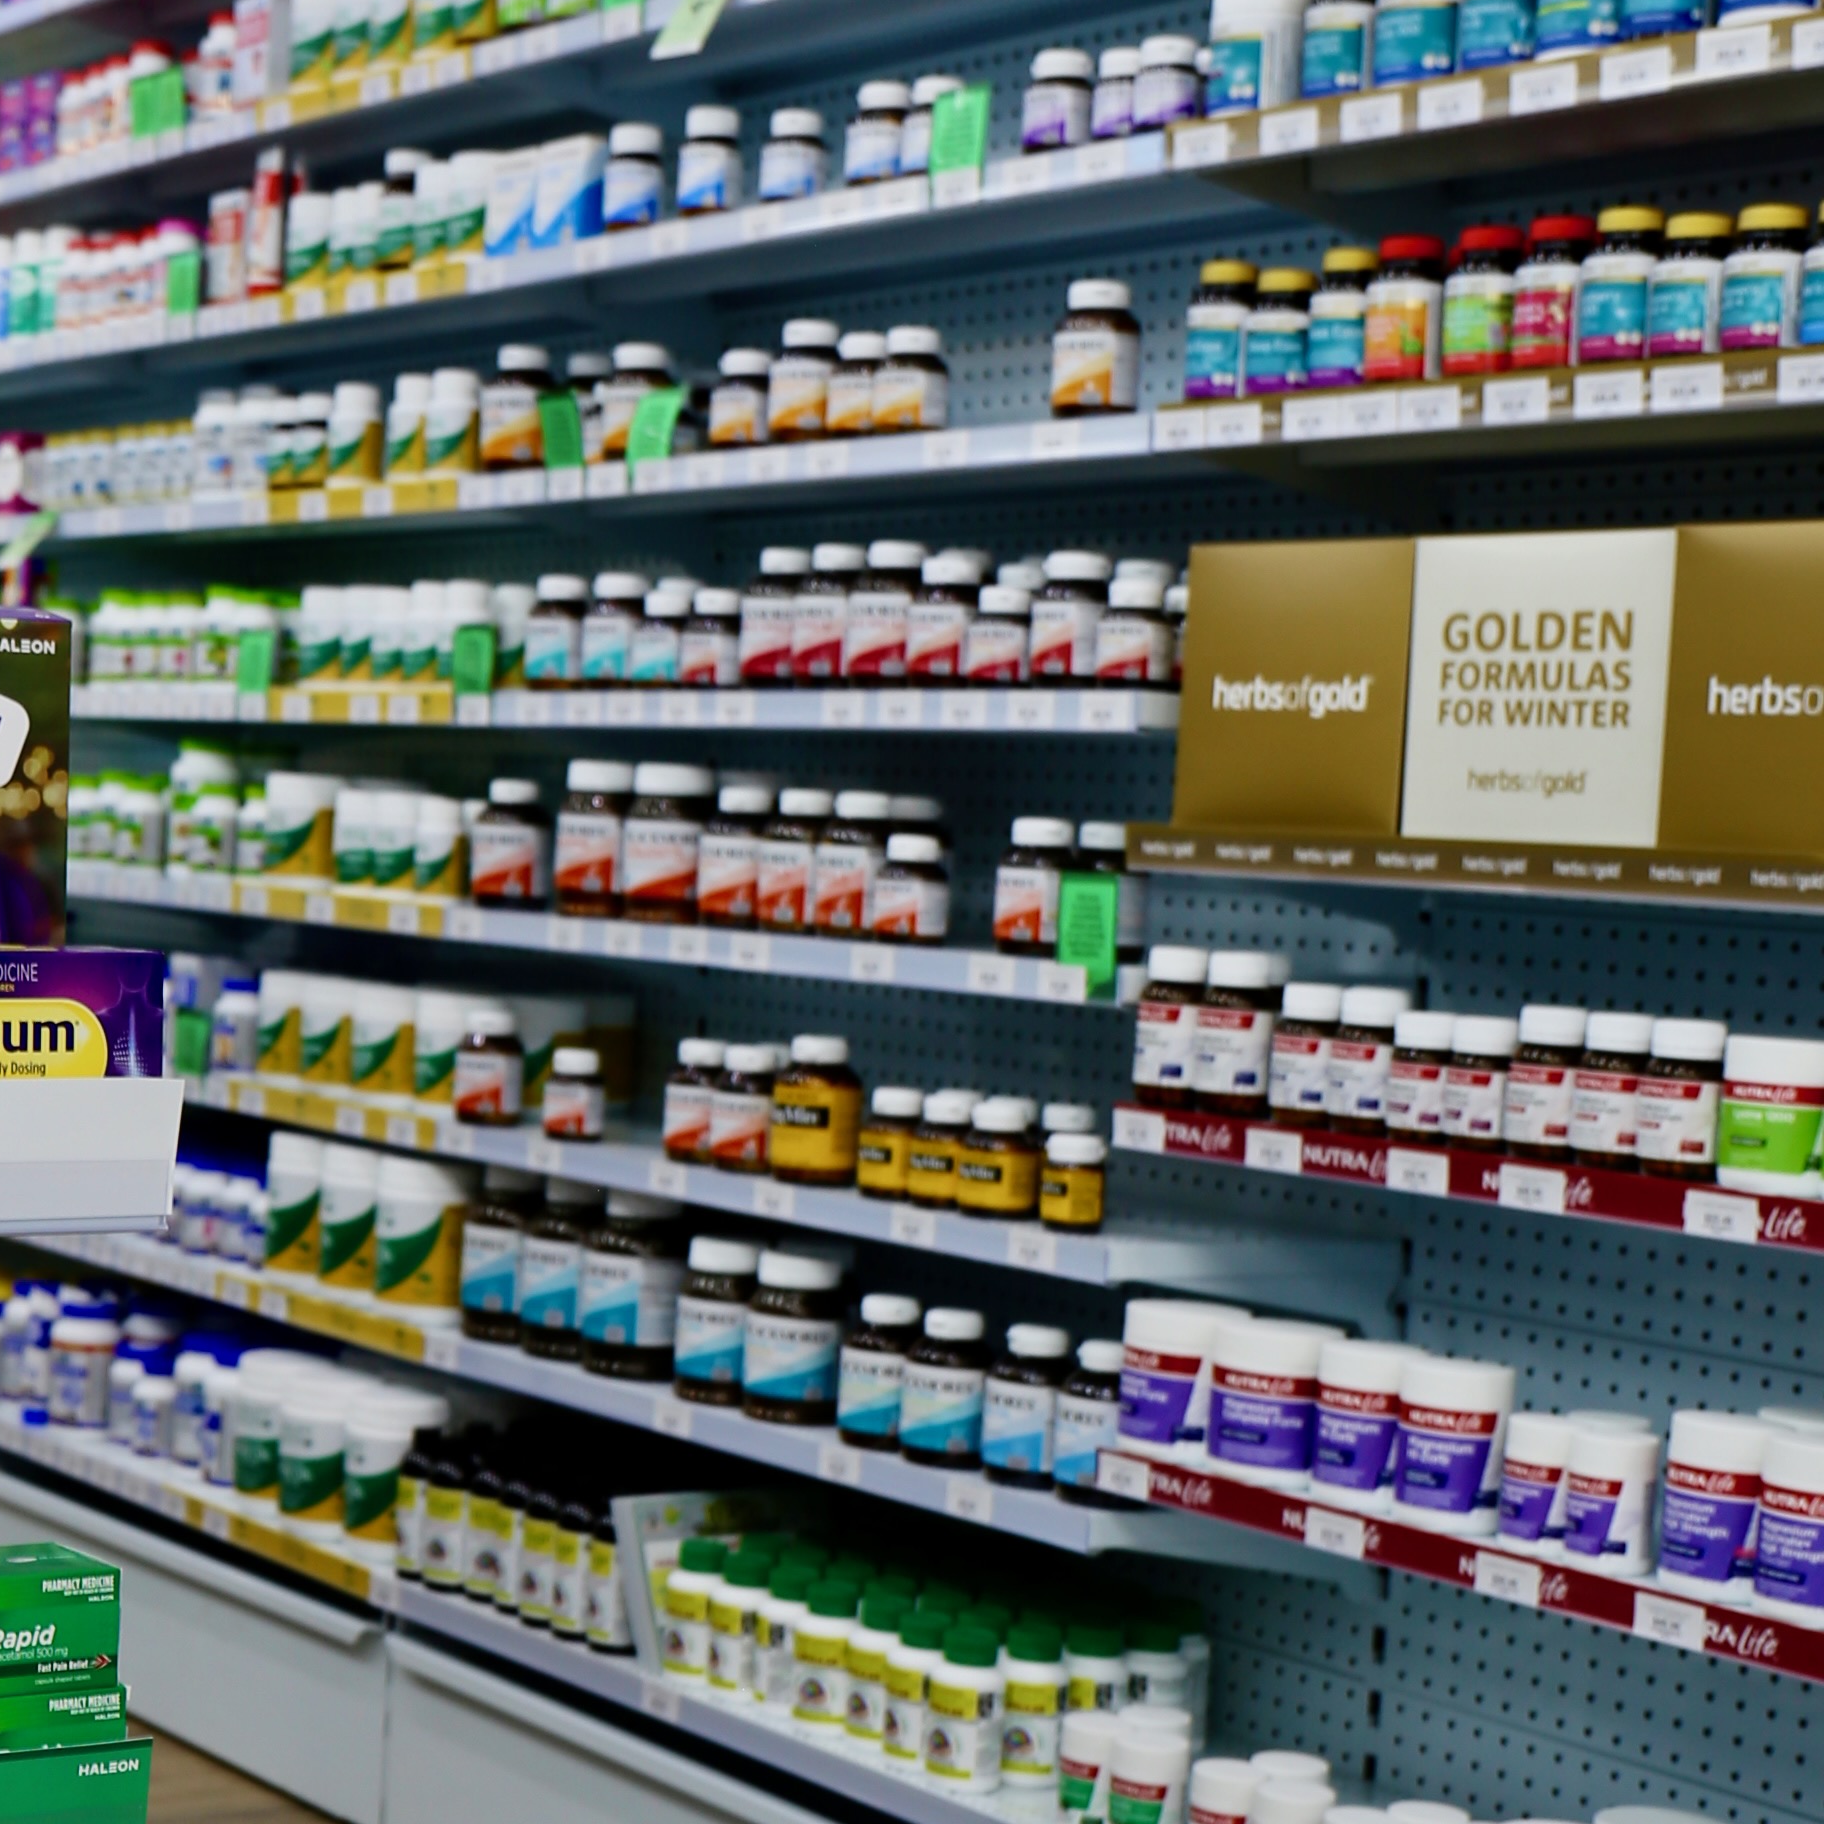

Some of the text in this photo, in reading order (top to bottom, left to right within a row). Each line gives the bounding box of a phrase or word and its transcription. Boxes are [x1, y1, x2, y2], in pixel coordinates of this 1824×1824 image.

[1442, 611, 1634, 653] GOLDEN
[1440, 660, 1632, 692] FORMULAS
[1212, 674, 1368, 719] herbsofgold
[1437, 700, 1630, 729] FOR WINTER
[79, 1758, 139, 1776] HALEON
